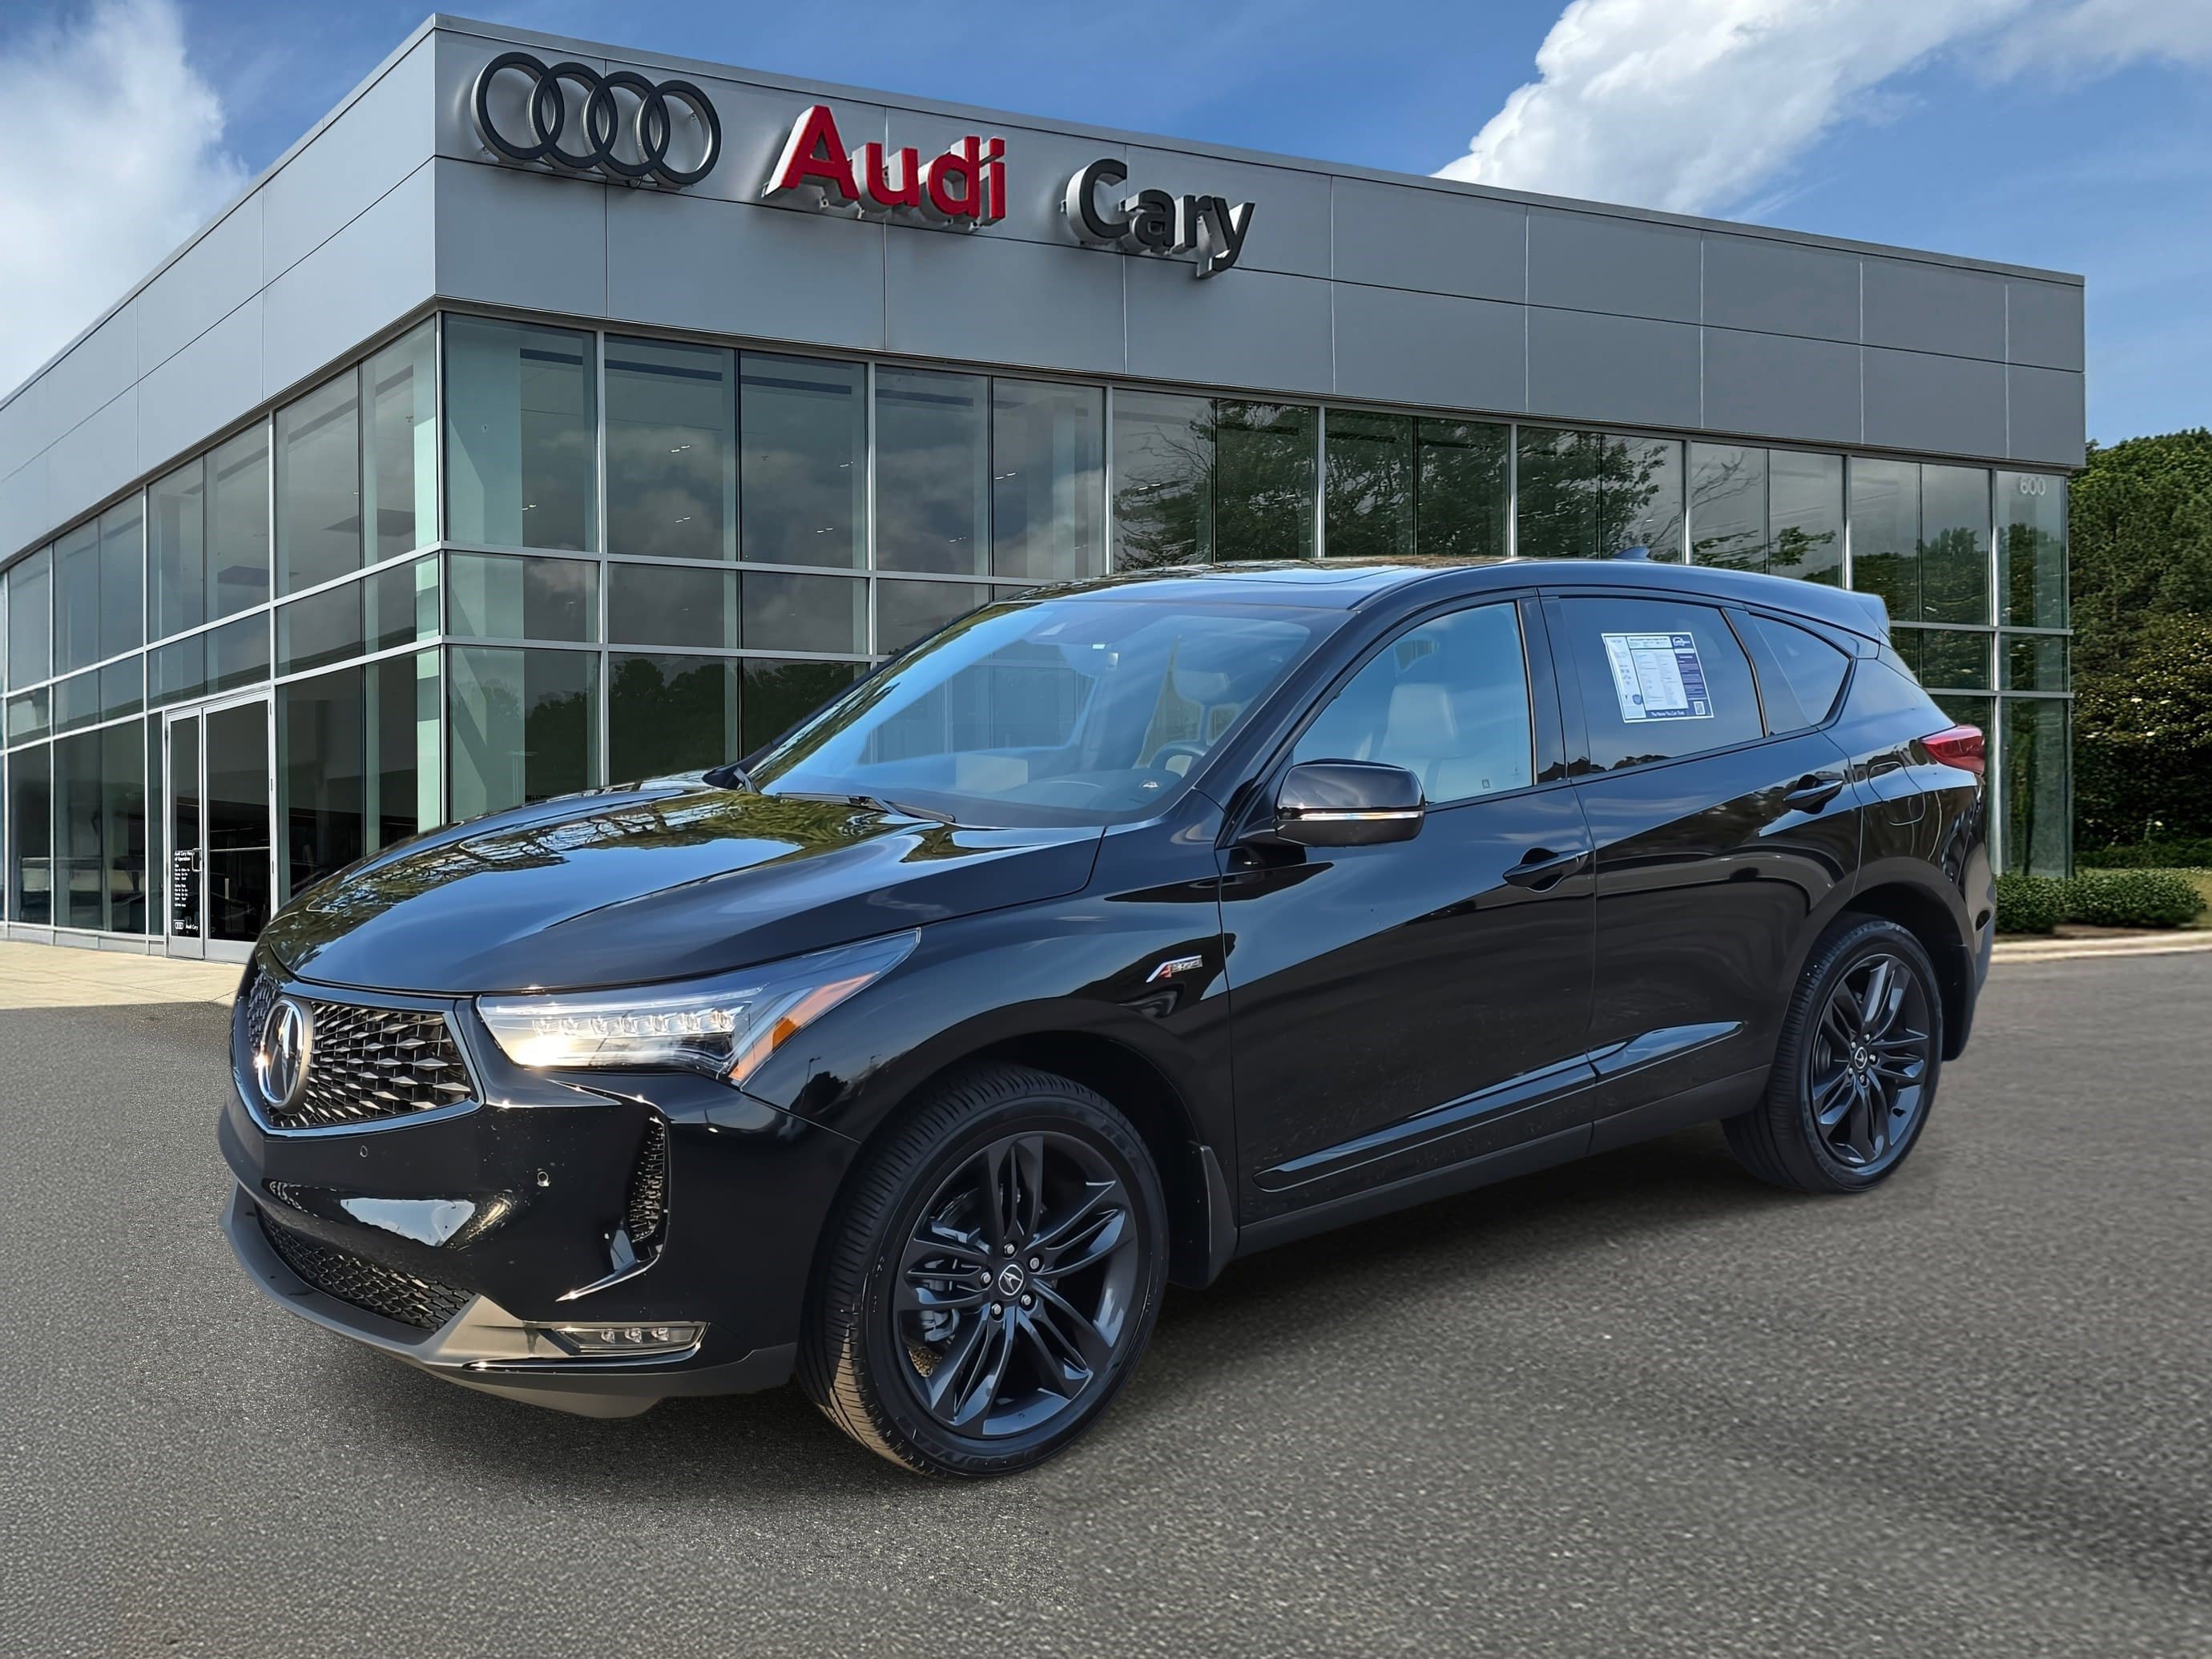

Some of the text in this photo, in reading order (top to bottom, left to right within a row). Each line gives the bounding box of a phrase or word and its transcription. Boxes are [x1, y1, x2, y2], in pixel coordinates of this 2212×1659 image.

[772, 104, 1255, 275] Audi Cary
[2020, 477, 2045, 496] 600
